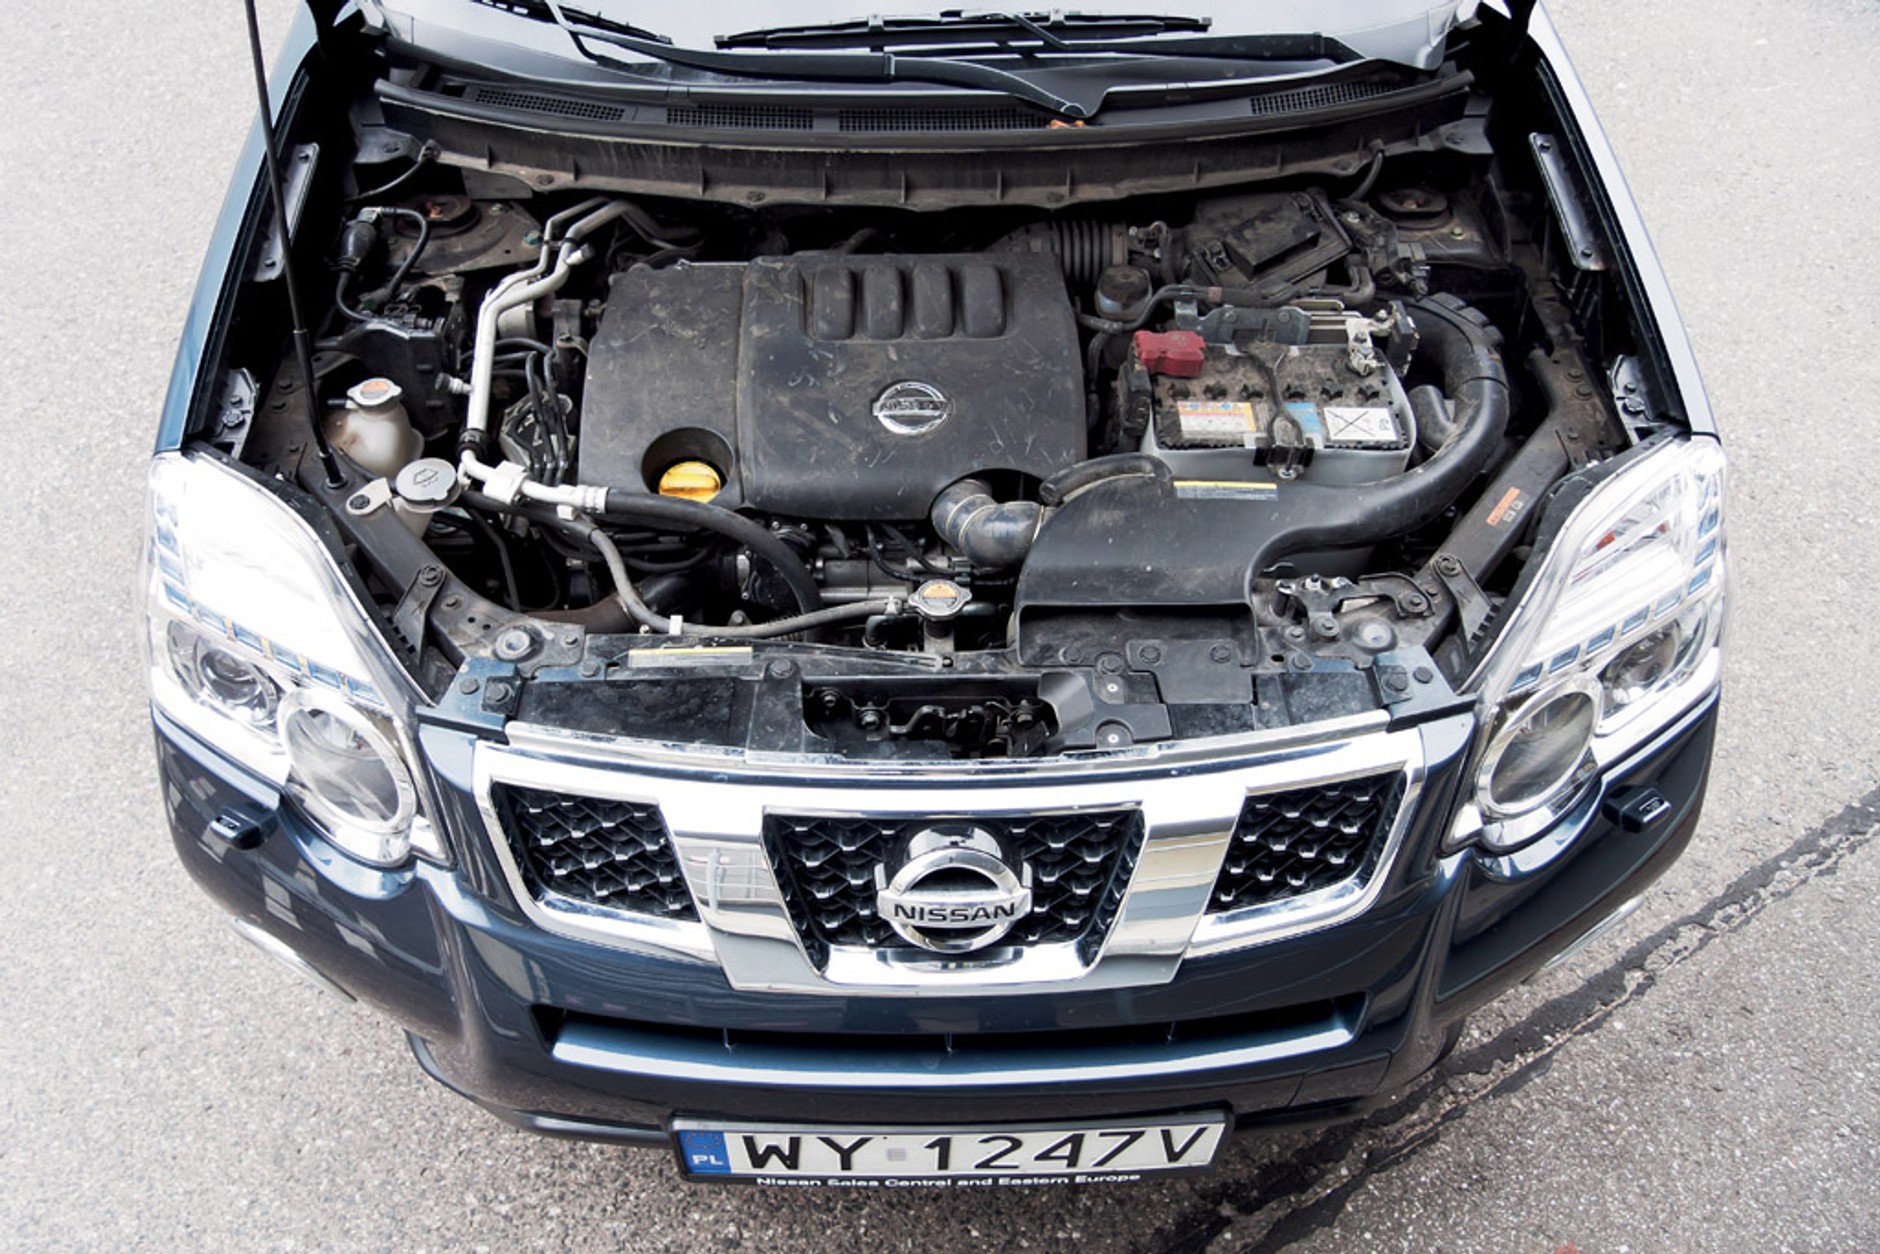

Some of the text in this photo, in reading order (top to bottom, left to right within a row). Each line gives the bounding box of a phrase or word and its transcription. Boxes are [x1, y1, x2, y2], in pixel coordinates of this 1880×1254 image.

[894, 903, 1015, 922] NISSAN
[742, 1127, 1208, 1170] WY 1247V
[692, 1154, 724, 1166] PL
[757, 1174, 1141, 1187] Nissan Sales Central and Eastern Europe
